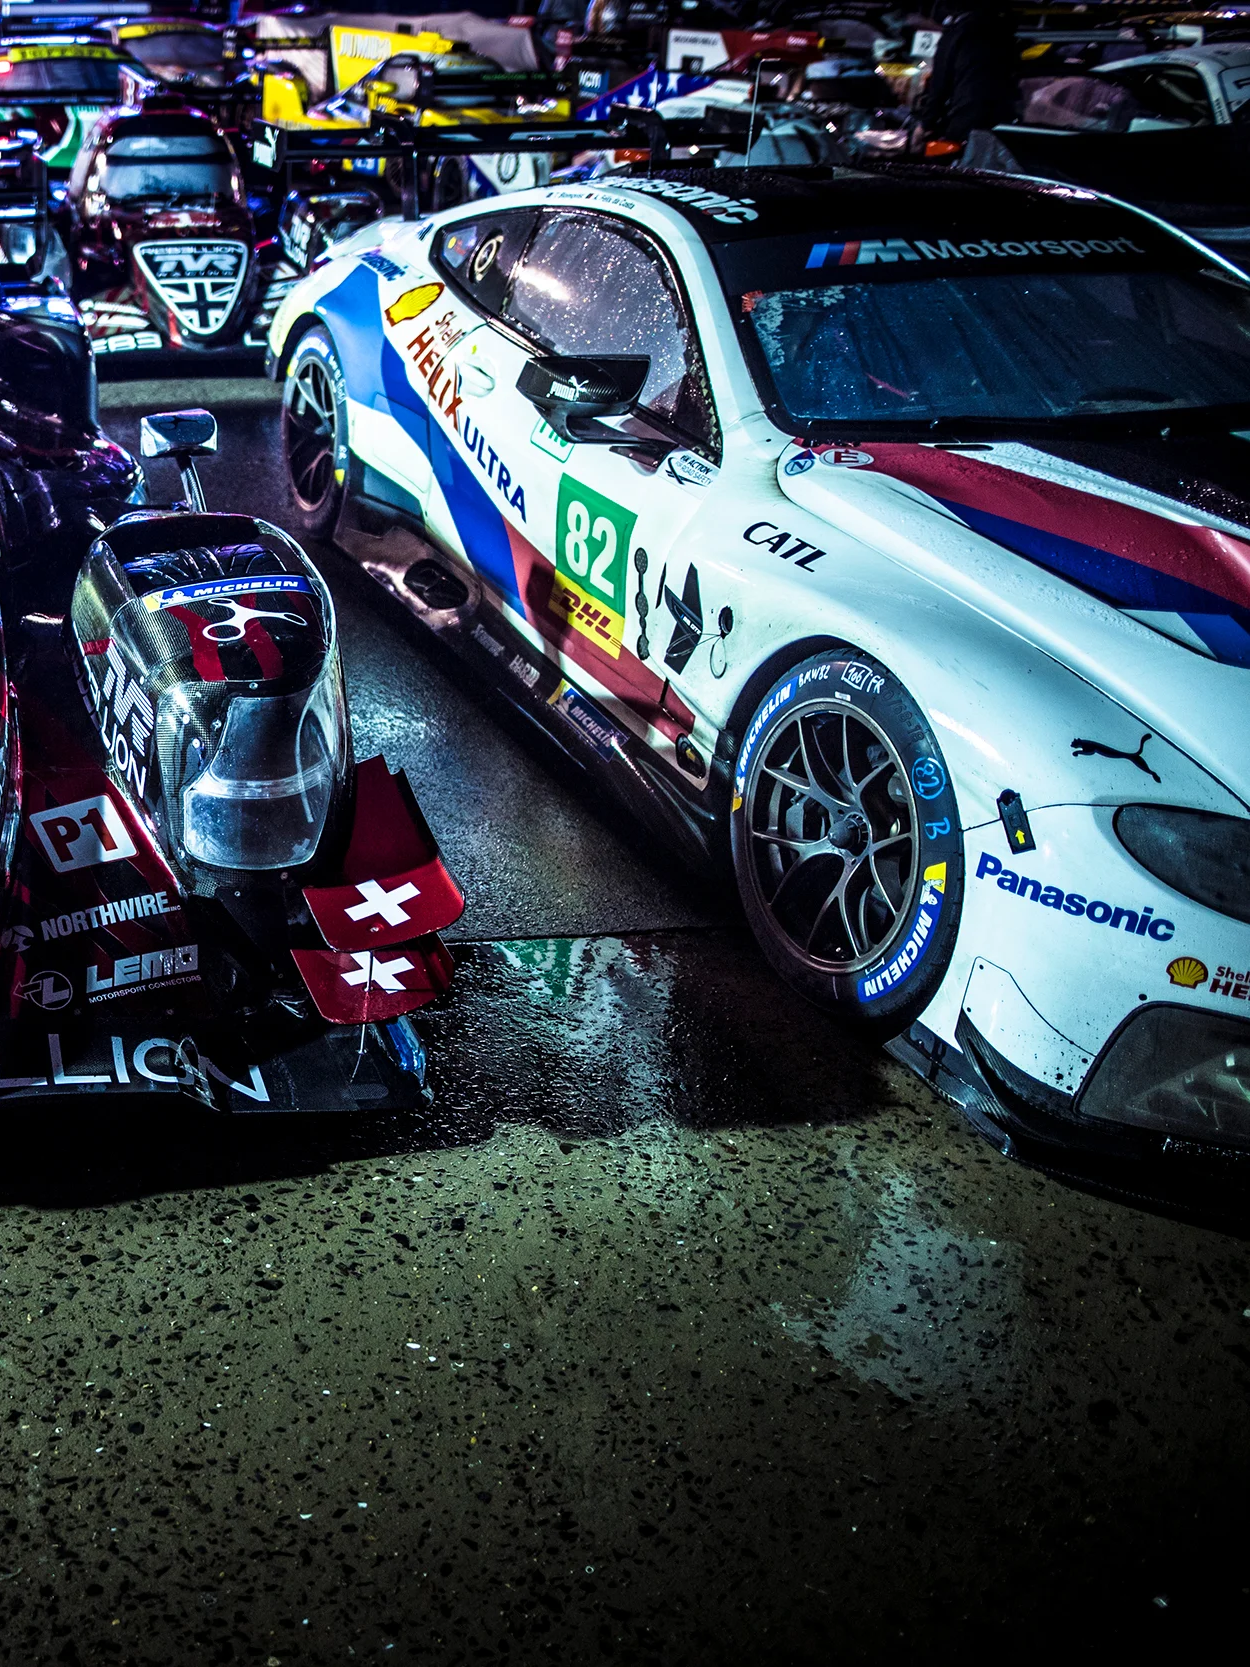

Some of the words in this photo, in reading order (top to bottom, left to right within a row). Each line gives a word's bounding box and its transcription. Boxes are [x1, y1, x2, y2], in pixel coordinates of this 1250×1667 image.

[154, 253, 238, 272] TVR
[913, 236, 1146, 261] Motorsport
[436, 311, 467, 349] Shell
[546, 380, 578, 402] PUMA
[406, 326, 464, 434] HELIX
[463, 415, 526, 523] ULTRA
[687, 459, 713, 475] ACTION
[564, 500, 618, 599] 82
[743, 521, 827, 573] CATL
[194, 580, 299, 598] MICHELIN
[559, 587, 614, 641] DHL
[740, 683, 792, 772] MICHELIN
[41, 808, 118, 863] P1
[40, 891, 171, 942] NORTHWIRE
[975, 852, 1175, 942] Panasonic
[86, 944, 199, 993] LEMO
[863, 909, 933, 997] MICHELIN
[88, 985, 147, 1004] MOTORSPORT
[148, 974, 202, 992] CONNECTORS
